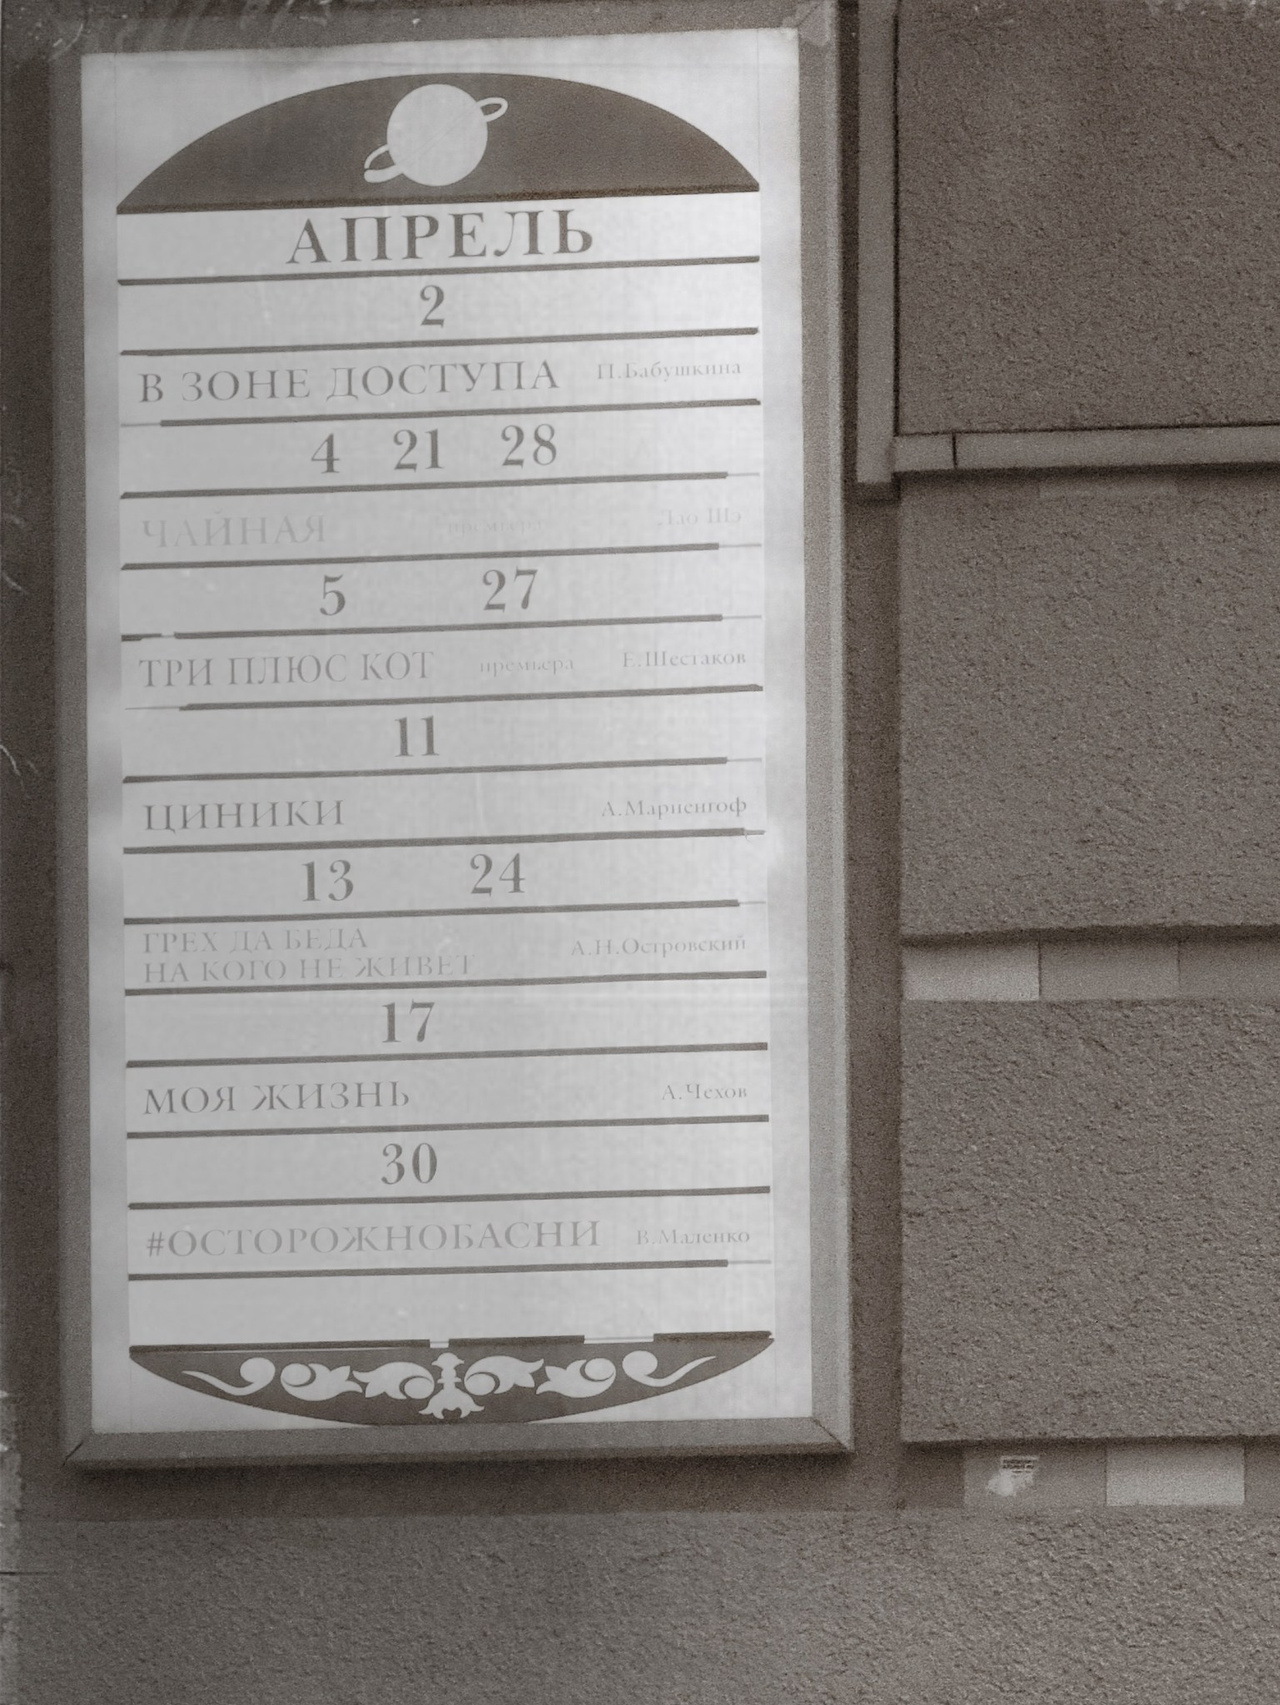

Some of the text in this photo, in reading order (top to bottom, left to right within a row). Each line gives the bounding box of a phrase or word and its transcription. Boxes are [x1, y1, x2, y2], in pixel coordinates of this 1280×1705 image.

[285, 208, 594, 266] АПРЕЛЬ
[420, 285, 444, 327] 2
[141, 360, 558, 402] В ЗОНЕ ДОСТУПА
[597, 361, 741, 382] П.Бабушкина
[312, 425, 557, 473] 4 21 28
[143, 512, 325, 547] ЧАЙНАЯ
[320, 568, 537, 615] 5 27
[139, 652, 433, 687] ТРИ ПЛЮС КОТ
[623, 650, 746, 668] Е.Шестаков
[395, 716, 438, 756] 11
[145, 800, 342, 833] ЦИНИКИ
[602, 797, 747, 820] А.Мариенгоф
[303, 853, 524, 901] 13 24
[144, 928, 367, 953] ГРЕХ ДА БЕДА
[571, 934, 745, 958] А.Н.Островский
[144, 955, 474, 981] НА КОГО НЕ ЖИВЕТ
[382, 1001, 434, 1042] 17
[144, 1082, 409, 1114] МОЯ ЖИЗНЬ
[662, 1083, 748, 1101] А.Чехов
[382, 1144, 437, 1185] 30
[146, 1221, 599, 1257] #ОСТОРОЖНОБАСНИ
